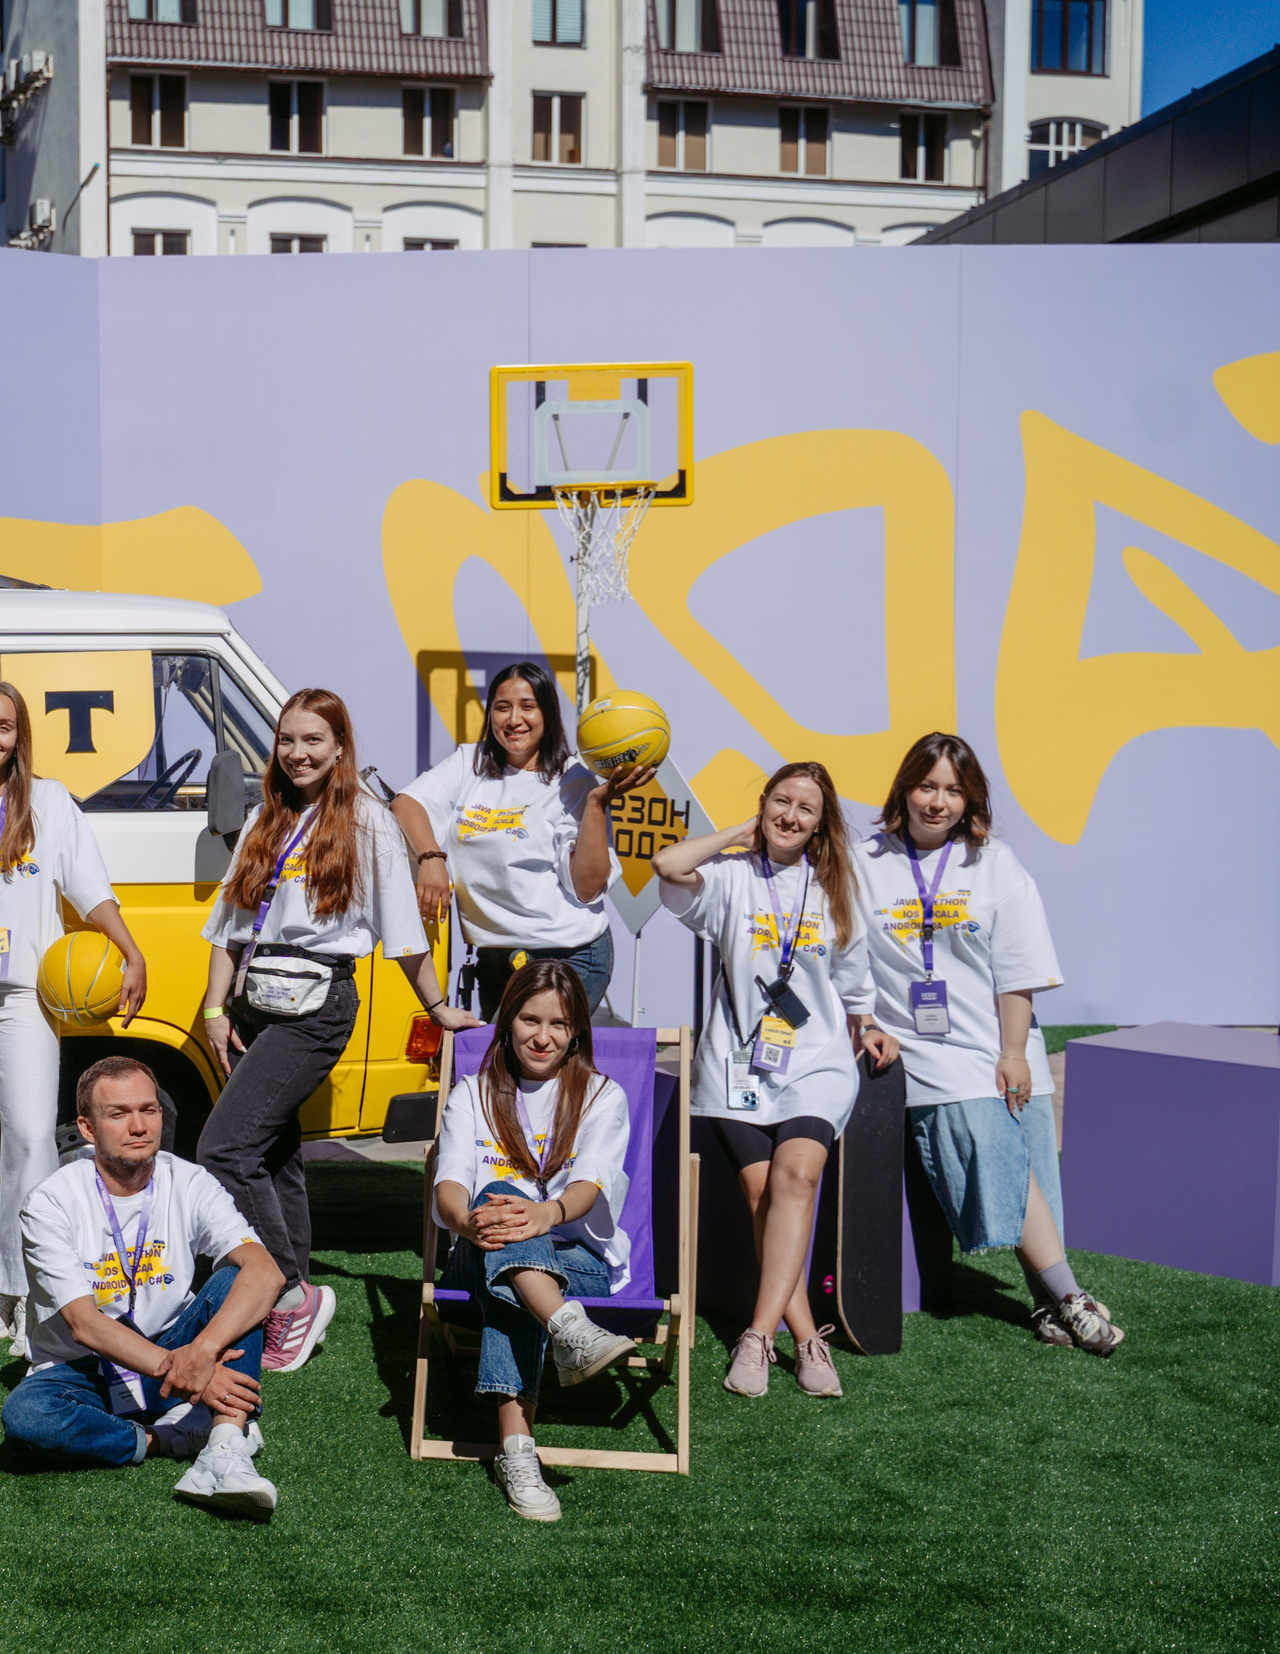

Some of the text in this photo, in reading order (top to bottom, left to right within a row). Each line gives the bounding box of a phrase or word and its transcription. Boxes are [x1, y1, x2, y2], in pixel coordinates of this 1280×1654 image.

[610, 795, 690, 829] езон
[473, 813, 488, 823] IOS
[892, 898, 967, 906] JAVA YTHON
[953, 922, 967, 930] C#
[803, 944, 817, 953] C#
[92, 1279, 127, 1290] NDROID
[149, 1275, 162, 1285] C#
